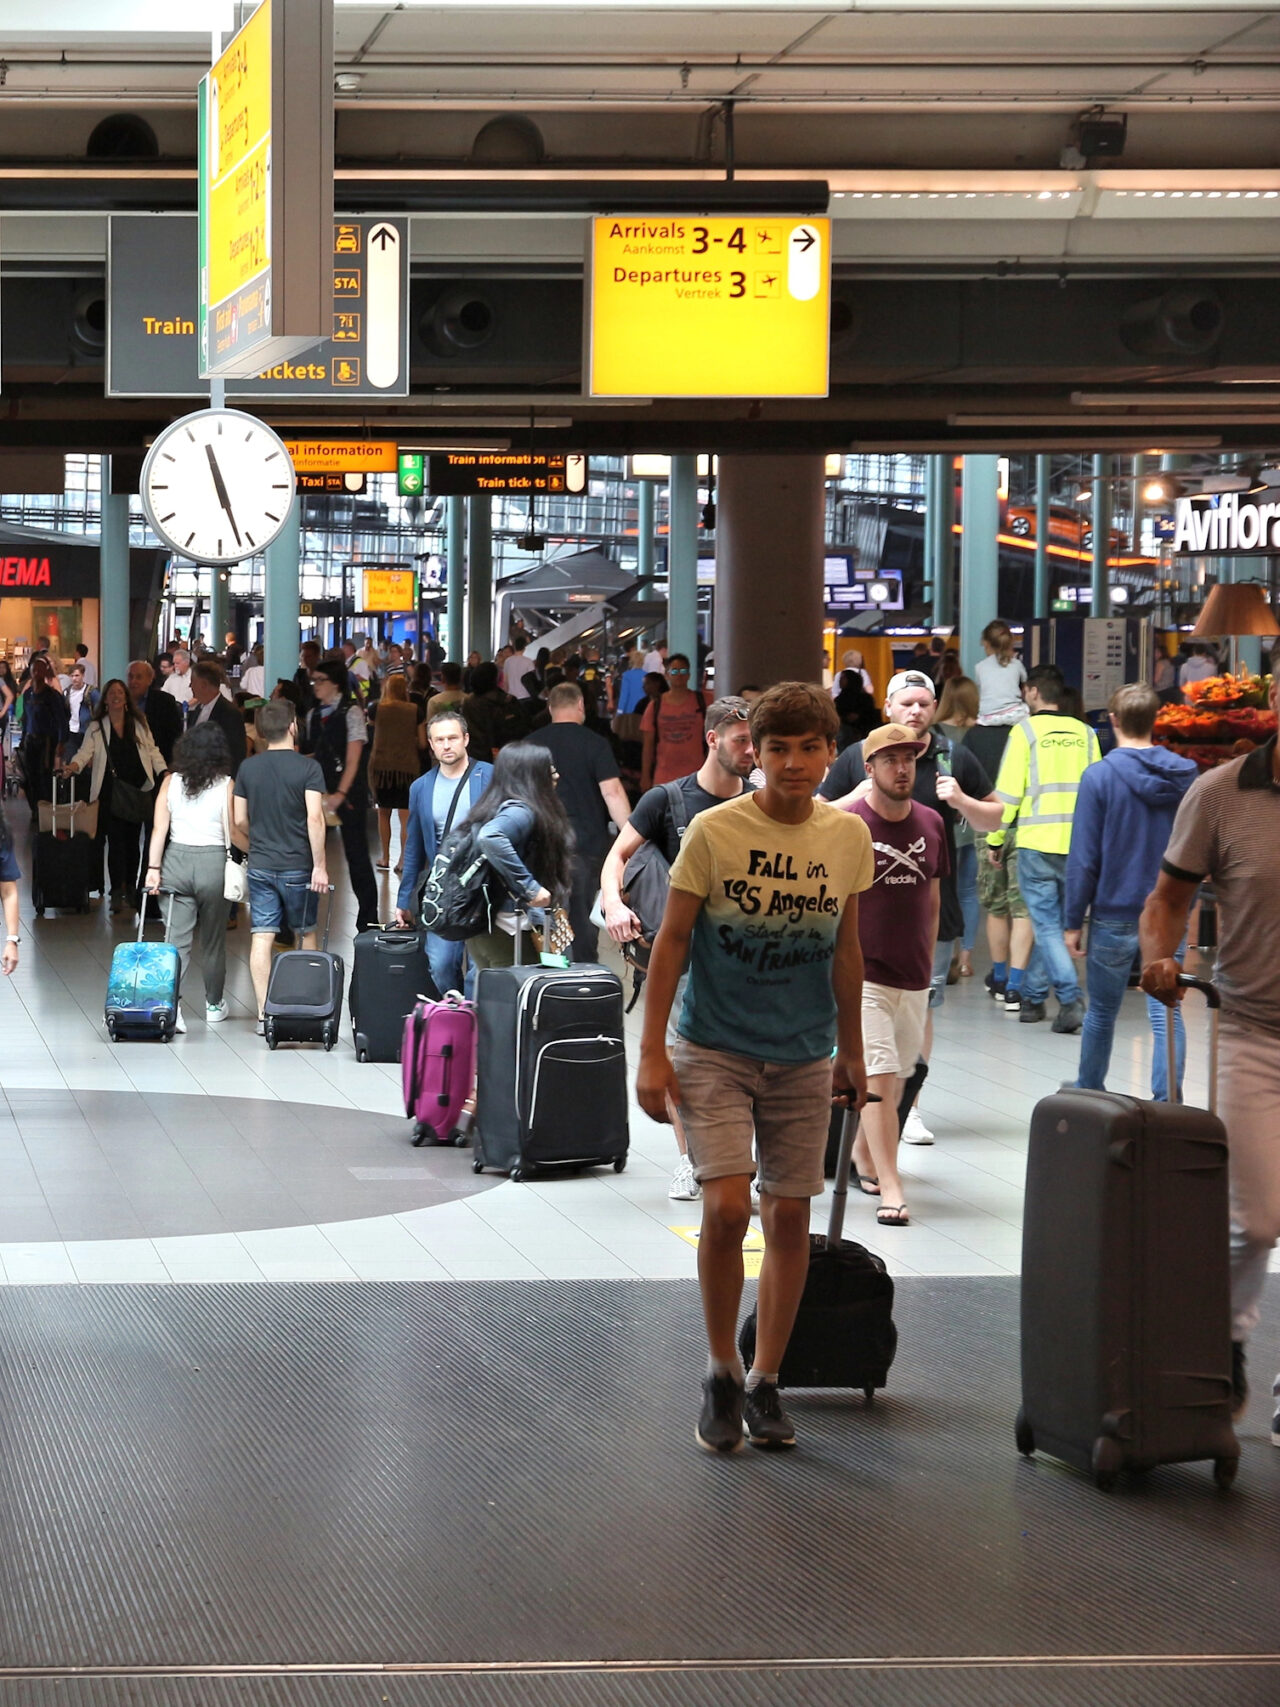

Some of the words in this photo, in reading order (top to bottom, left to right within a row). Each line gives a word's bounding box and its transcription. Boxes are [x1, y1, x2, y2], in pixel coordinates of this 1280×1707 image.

[609, 222, 685, 239] Arrivals
[691, 227, 747, 254] 3-4
[622, 244, 685, 255] Aankomst
[334, 278, 358, 289] STA
[614, 267, 722, 286] Departures
[729, 271, 747, 298] 3
[675, 288, 721, 299] Vertrek
[143, 317, 195, 335] Train
[304, 444, 383, 456] information
[448, 454, 475, 465] Train
[301, 476, 324, 487] Taxi
[477, 477, 505, 488] Train
[508, 477, 546, 488] tickts
[303, 604, 310, 613] D
[747, 850, 798, 880] FALL
[806, 861, 829, 879] in
[764, 884, 839, 923] Angeles
